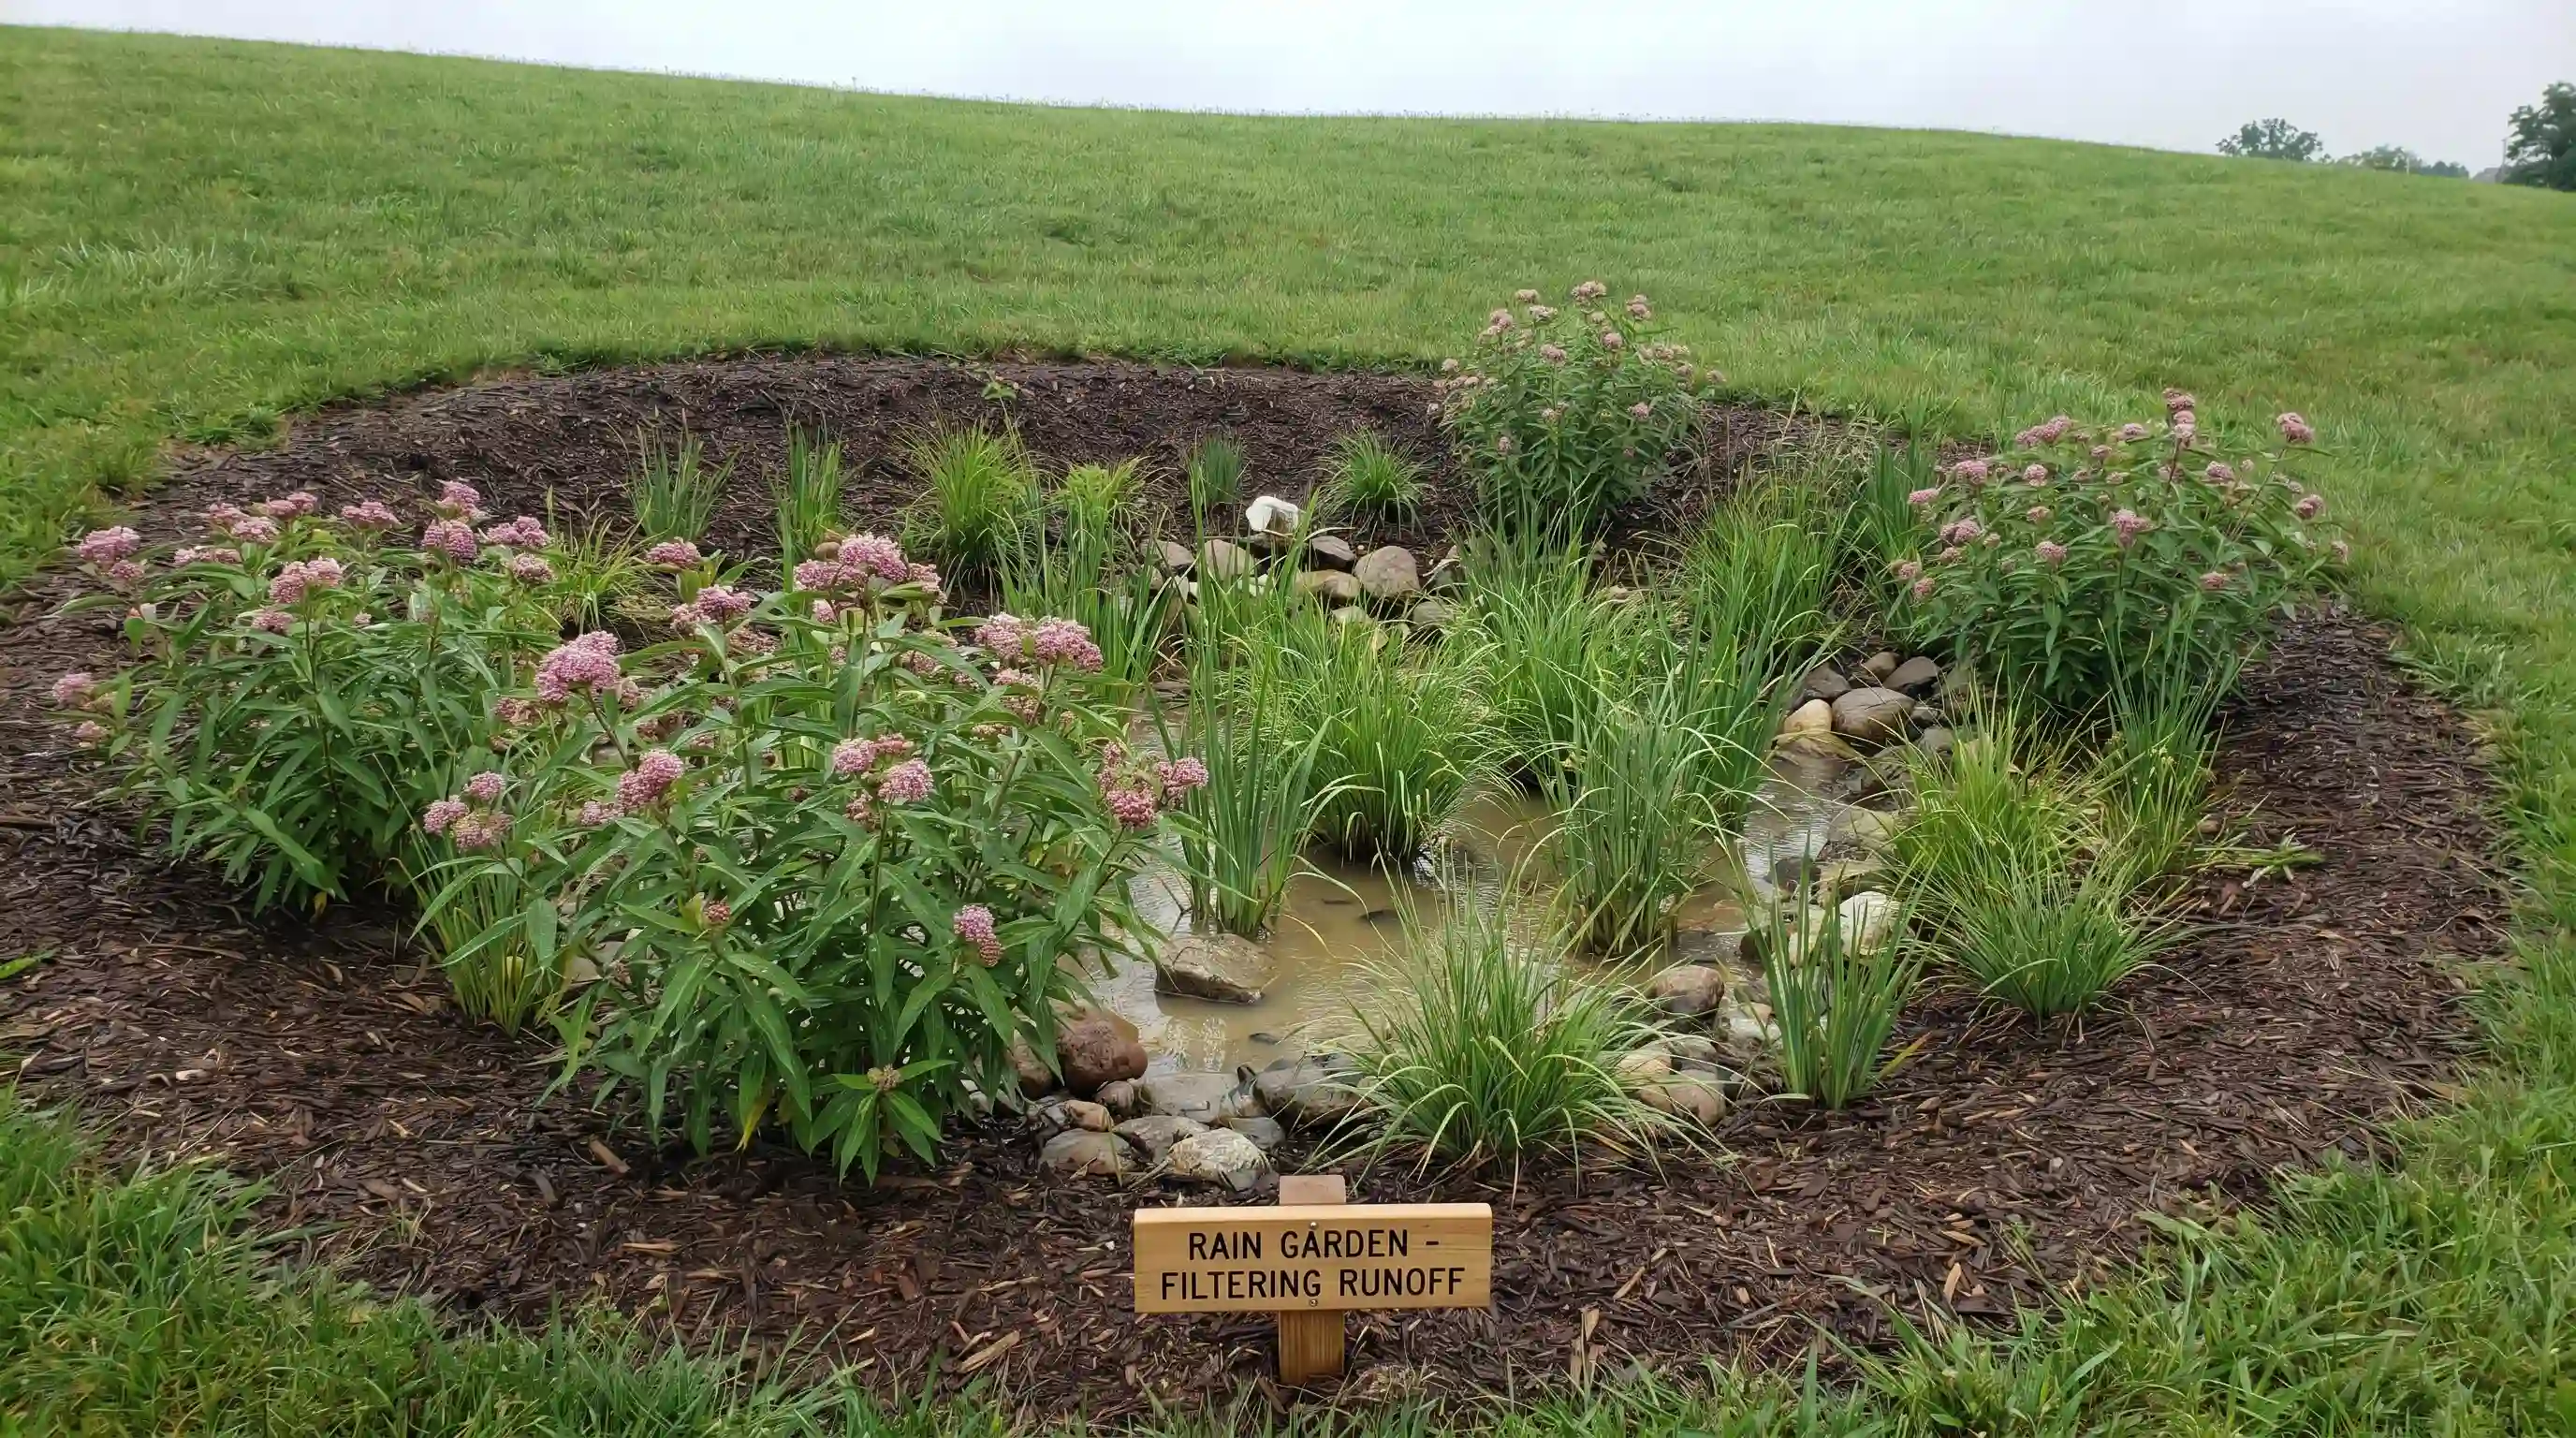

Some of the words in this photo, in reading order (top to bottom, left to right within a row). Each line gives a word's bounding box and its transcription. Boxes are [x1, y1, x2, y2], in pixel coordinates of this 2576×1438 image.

[1189, 1231, 1262, 1261] RAIN
[1281, 1228, 1408, 1259] GARDEN
[1162, 1269, 1321, 1300] FILTERING
[1339, 1267, 1466, 1297] RUNOFF
